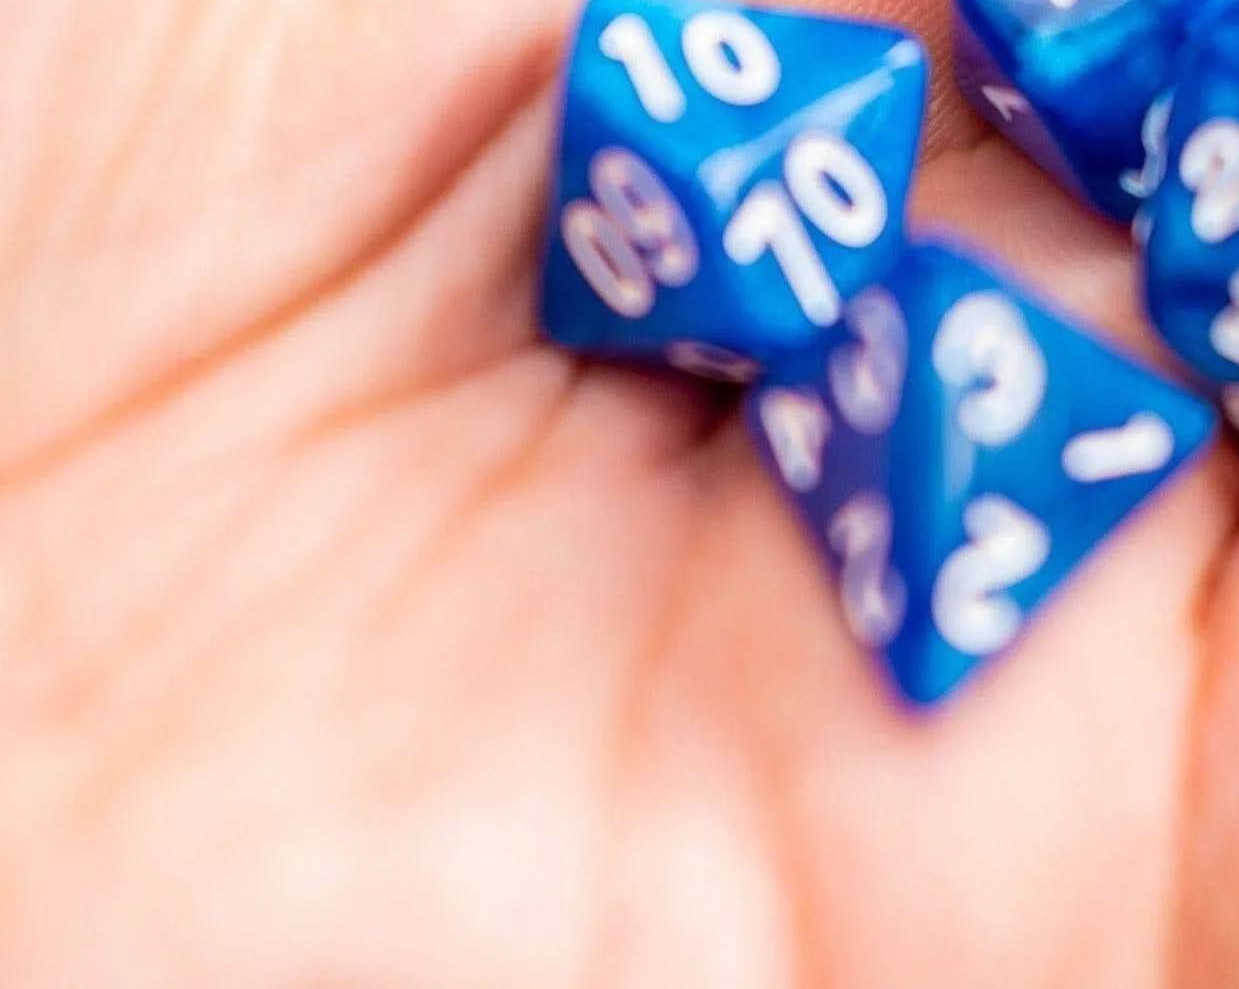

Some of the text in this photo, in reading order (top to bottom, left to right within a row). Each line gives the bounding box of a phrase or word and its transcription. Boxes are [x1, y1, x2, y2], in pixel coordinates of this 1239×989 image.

[598, 9, 781, 122] 10
[1061, 411, 1174, 482] 1
[931, 492, 1051, 656] 2
